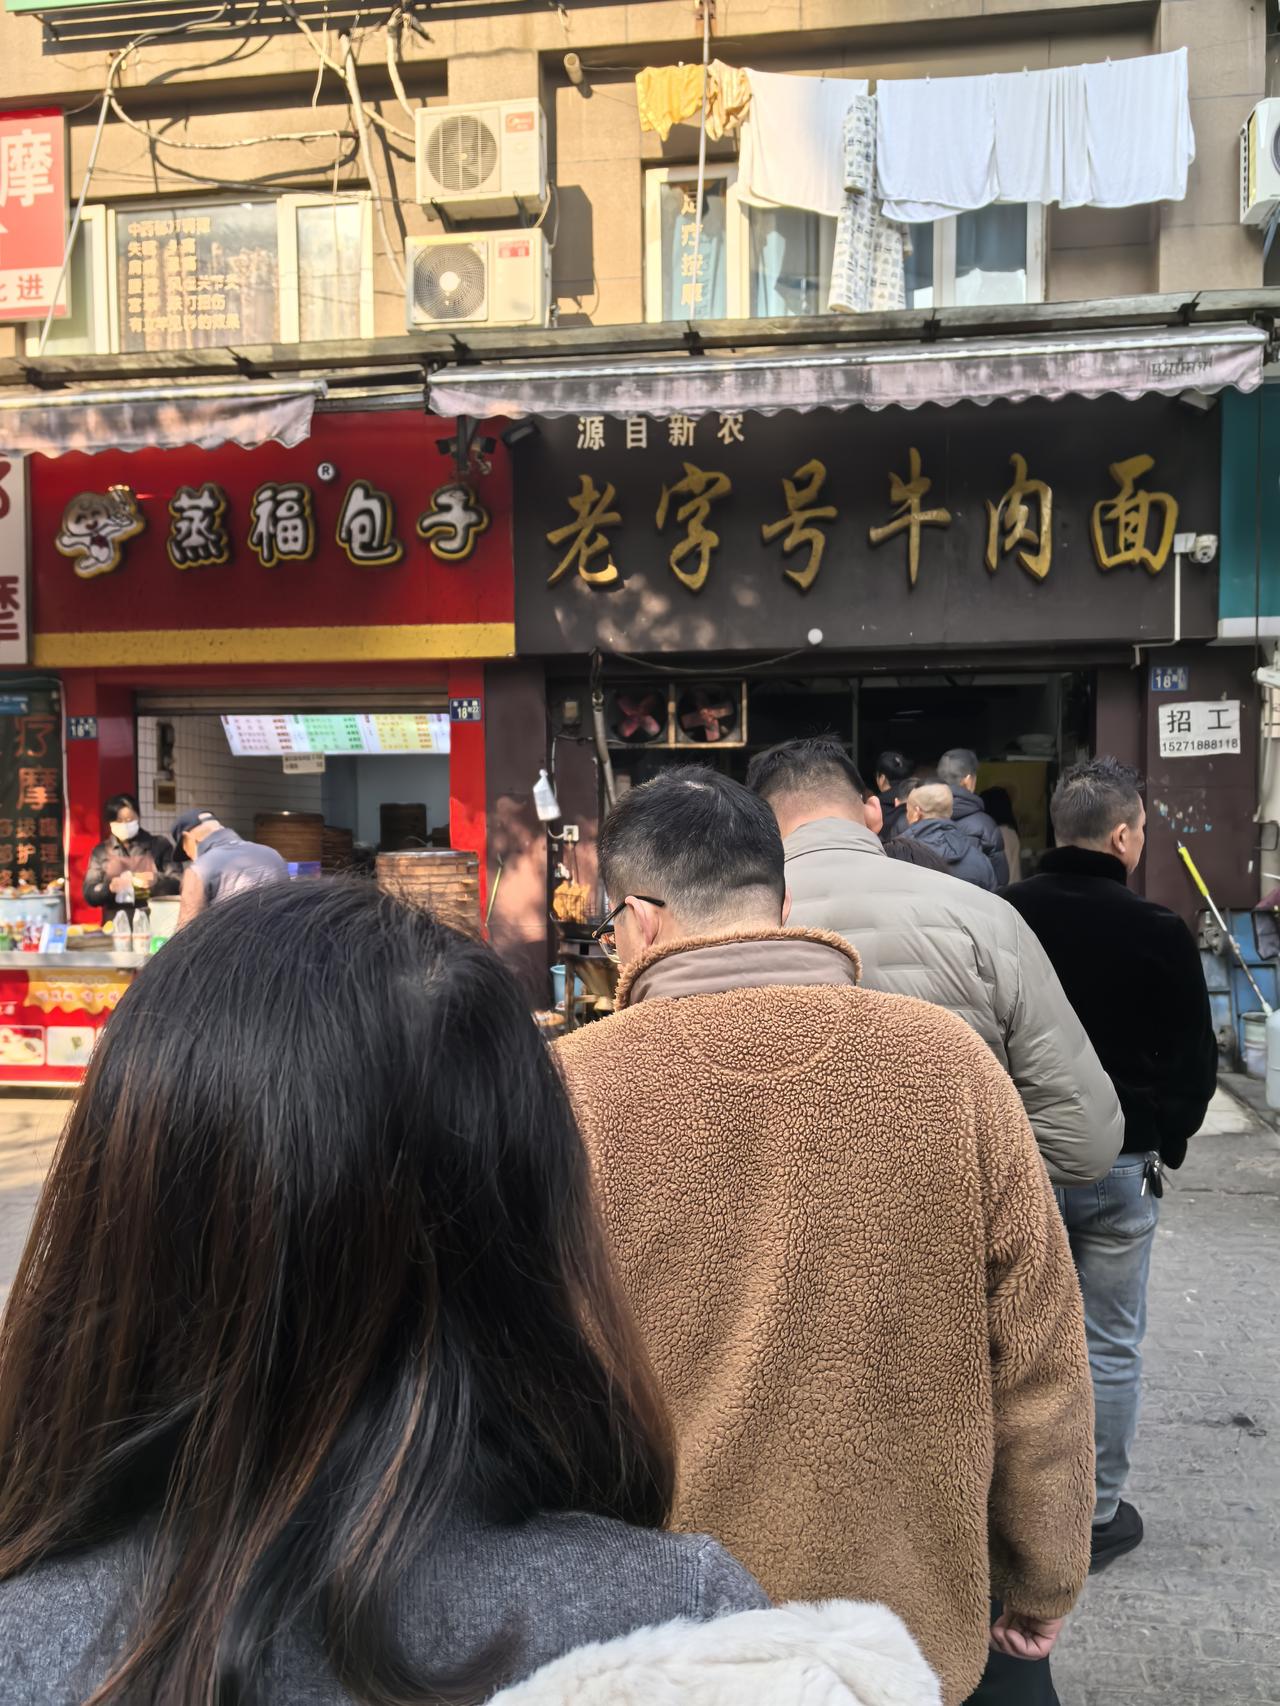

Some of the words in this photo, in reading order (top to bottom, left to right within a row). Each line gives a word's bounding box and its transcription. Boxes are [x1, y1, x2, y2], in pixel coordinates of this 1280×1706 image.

[577, 414, 745, 450] 源自新农
[168, 480, 488, 570] 蒸福包子
[546, 447, 1179, 591] 老字号牛肉面
[1167, 709, 1232, 733] 招工
[1162, 739, 1238, 752] 15271888118
